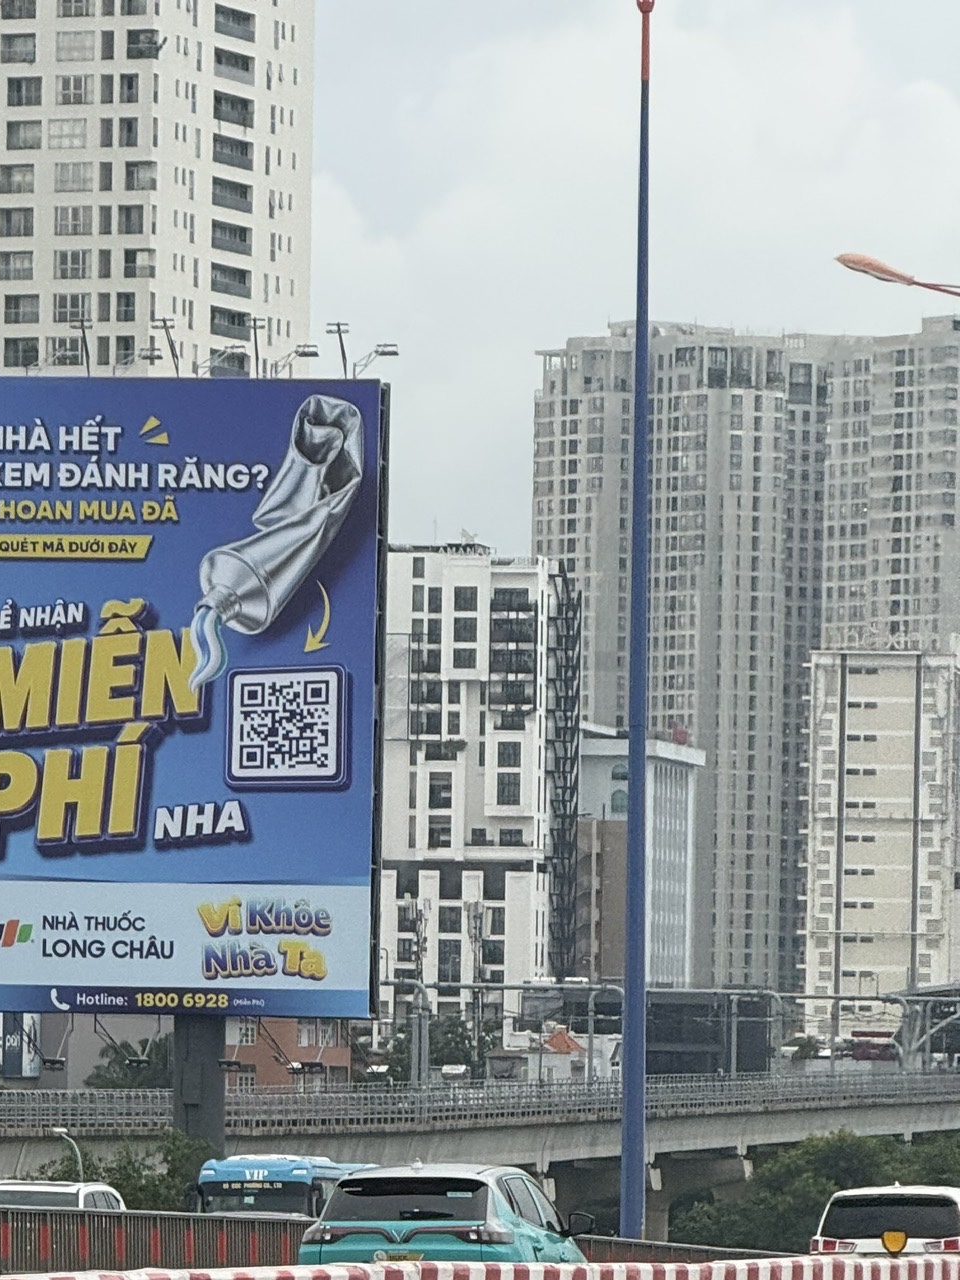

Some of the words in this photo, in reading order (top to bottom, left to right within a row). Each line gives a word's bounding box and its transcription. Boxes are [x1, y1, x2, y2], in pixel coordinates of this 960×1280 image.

[58, 414, 122, 452] HẾT
[58, 456, 150, 488] ĐÁNH
[158, 456, 269, 489] RĂNG?
[79, 501, 136, 521] MUA
[142, 495, 179, 522] ĐÃ
[42, 537, 66, 553] MÃ
[68, 537, 105, 553] DƯỚI
[108, 537, 138, 554] ĐÂY
[19, 599, 84, 629] NHẬN
[153, 800, 246, 841] NHA
[42, 912, 79, 931] NHÀ
[84, 910, 146, 932] THUỐC
[42, 939, 106, 959] LONG
[112, 935, 174, 960] CHÂU
[279, 940, 328, 980] Ta
[76, 992, 128, 1006] Hotline:
[135, 993, 178, 1007] 1800
[183, 994, 228, 1008] 6928
[245, 1169, 268, 1180] VIP
